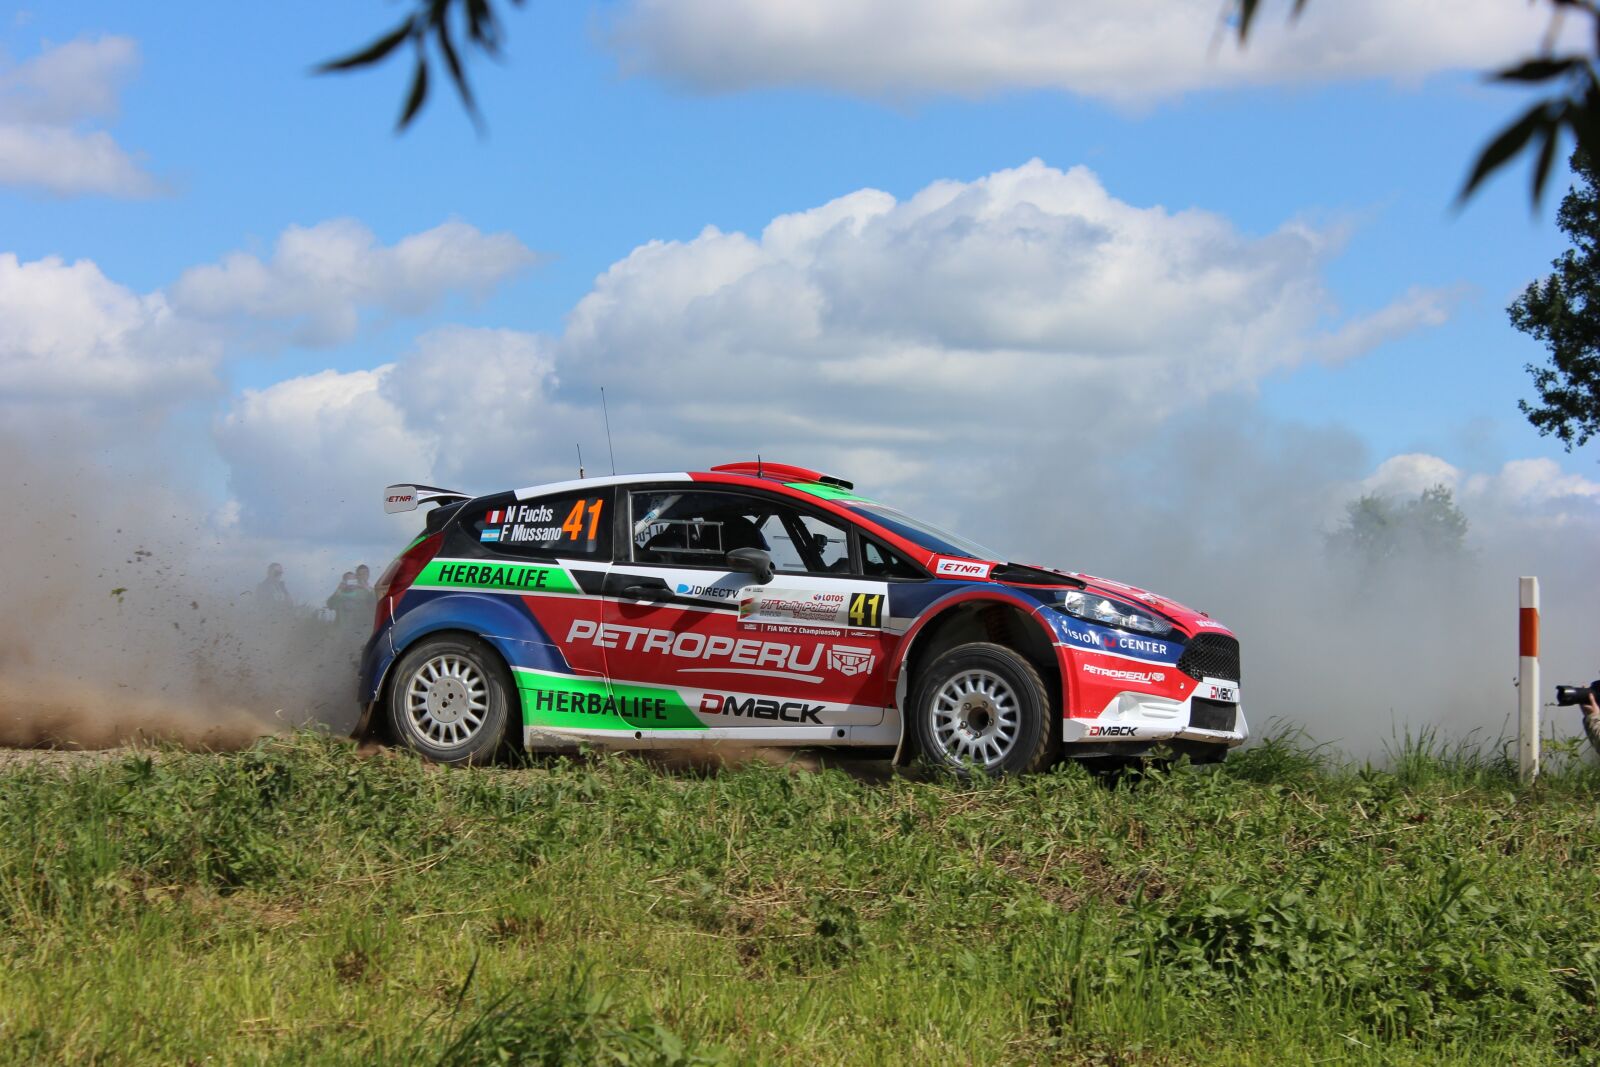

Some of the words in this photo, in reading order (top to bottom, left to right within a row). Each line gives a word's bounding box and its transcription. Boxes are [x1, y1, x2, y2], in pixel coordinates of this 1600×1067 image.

[388, 495, 411, 503] ETNA
[504, 505, 516, 523] N
[517, 504, 553, 523] Fuchs
[561, 499, 603, 541] 41
[500, 524, 510, 542] F
[511, 524, 562, 542] Mussano
[438, 564, 549, 588] HERBALIFE
[943, 563, 980, 574] ETNA
[694, 585, 739, 599] DIRECTV
[822, 594, 845, 603] LOTOS
[777, 600, 801, 613] Rally
[801, 602, 840, 614] Poland
[849, 593, 880, 627] 41
[779, 626, 793, 634] WRC
[799, 628, 841, 637] Championship
[1061, 624, 1100, 646] VISION
[1119, 638, 1167, 655] CENTER
[565, 619, 825, 672] PETROPERU
[1083, 663, 1151, 682] PETROPERU
[536, 689, 667, 720] HERBALIFE
